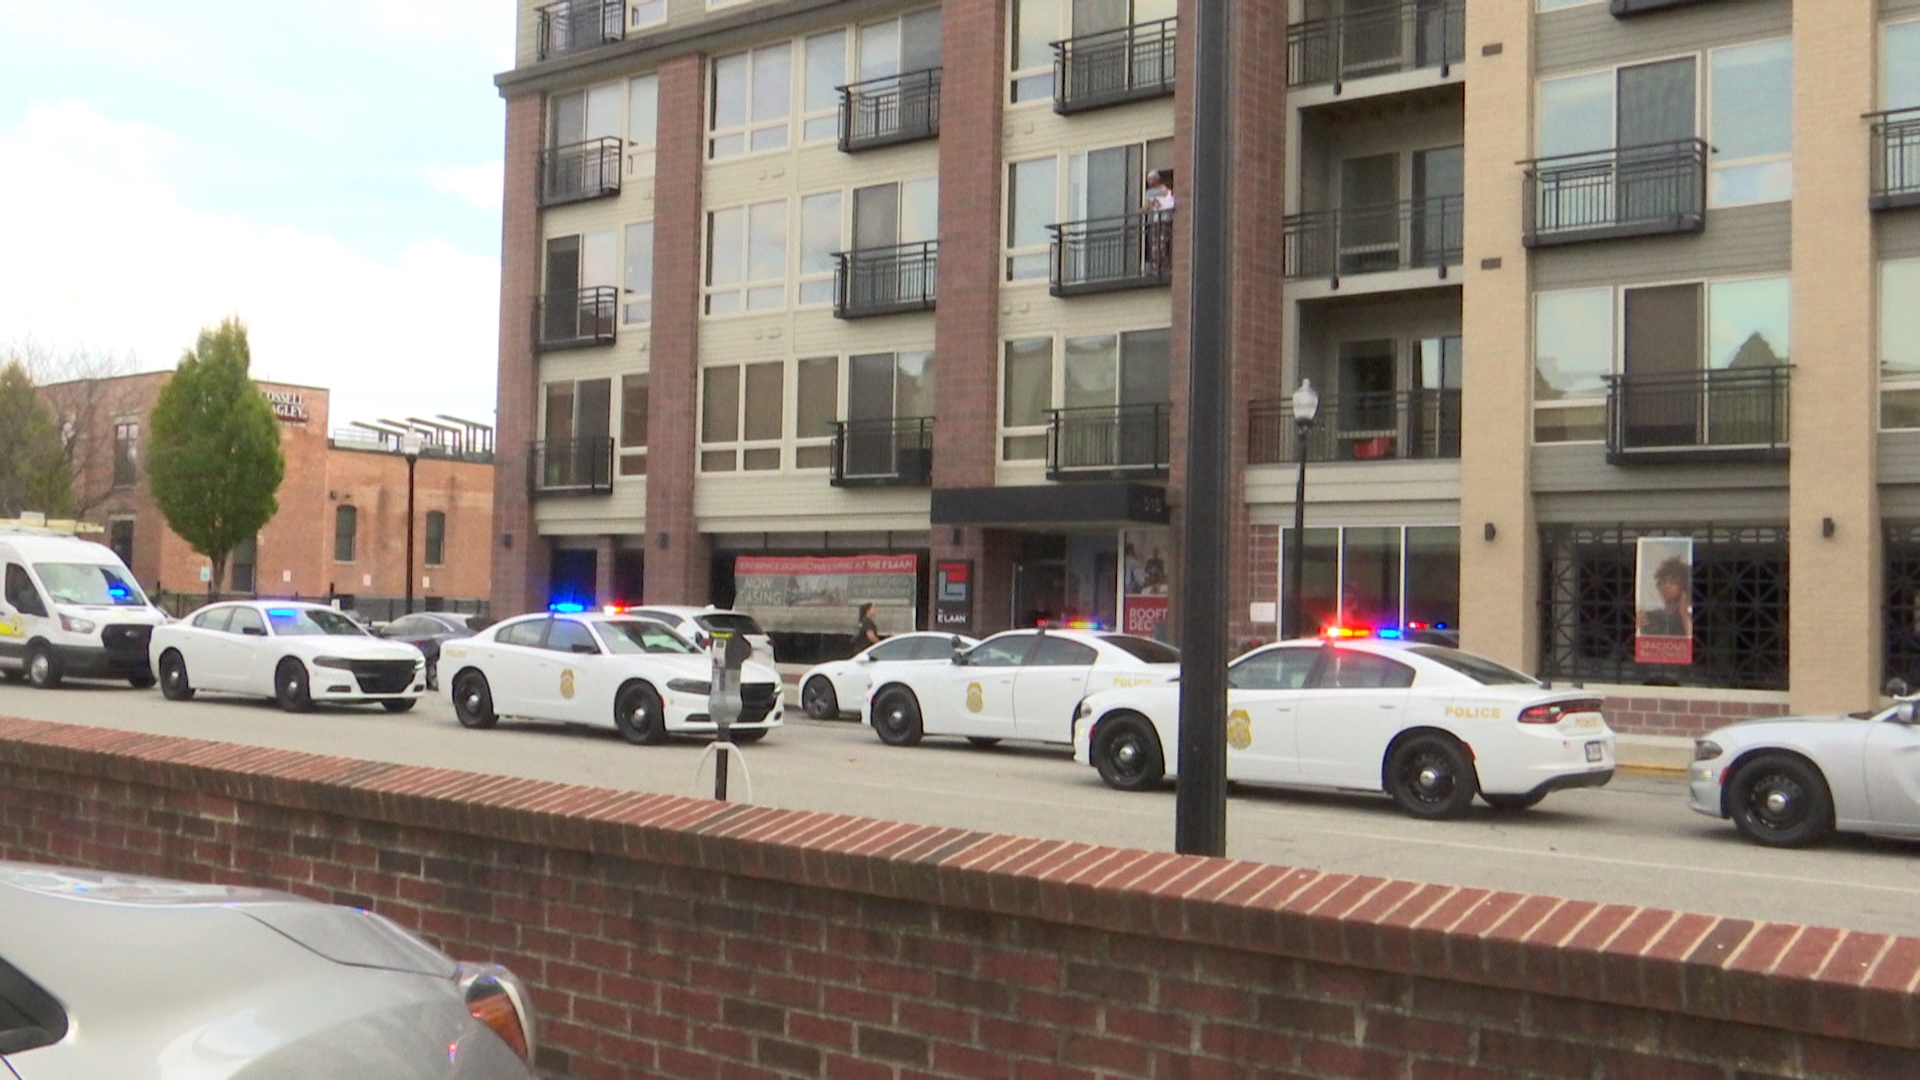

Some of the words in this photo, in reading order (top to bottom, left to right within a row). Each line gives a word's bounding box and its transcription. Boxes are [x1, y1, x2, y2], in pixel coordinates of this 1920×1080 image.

[261, 391, 303, 405] OSSELL
[744, 577, 770, 589] NOW
[1445, 705, 1502, 719] POLICE
